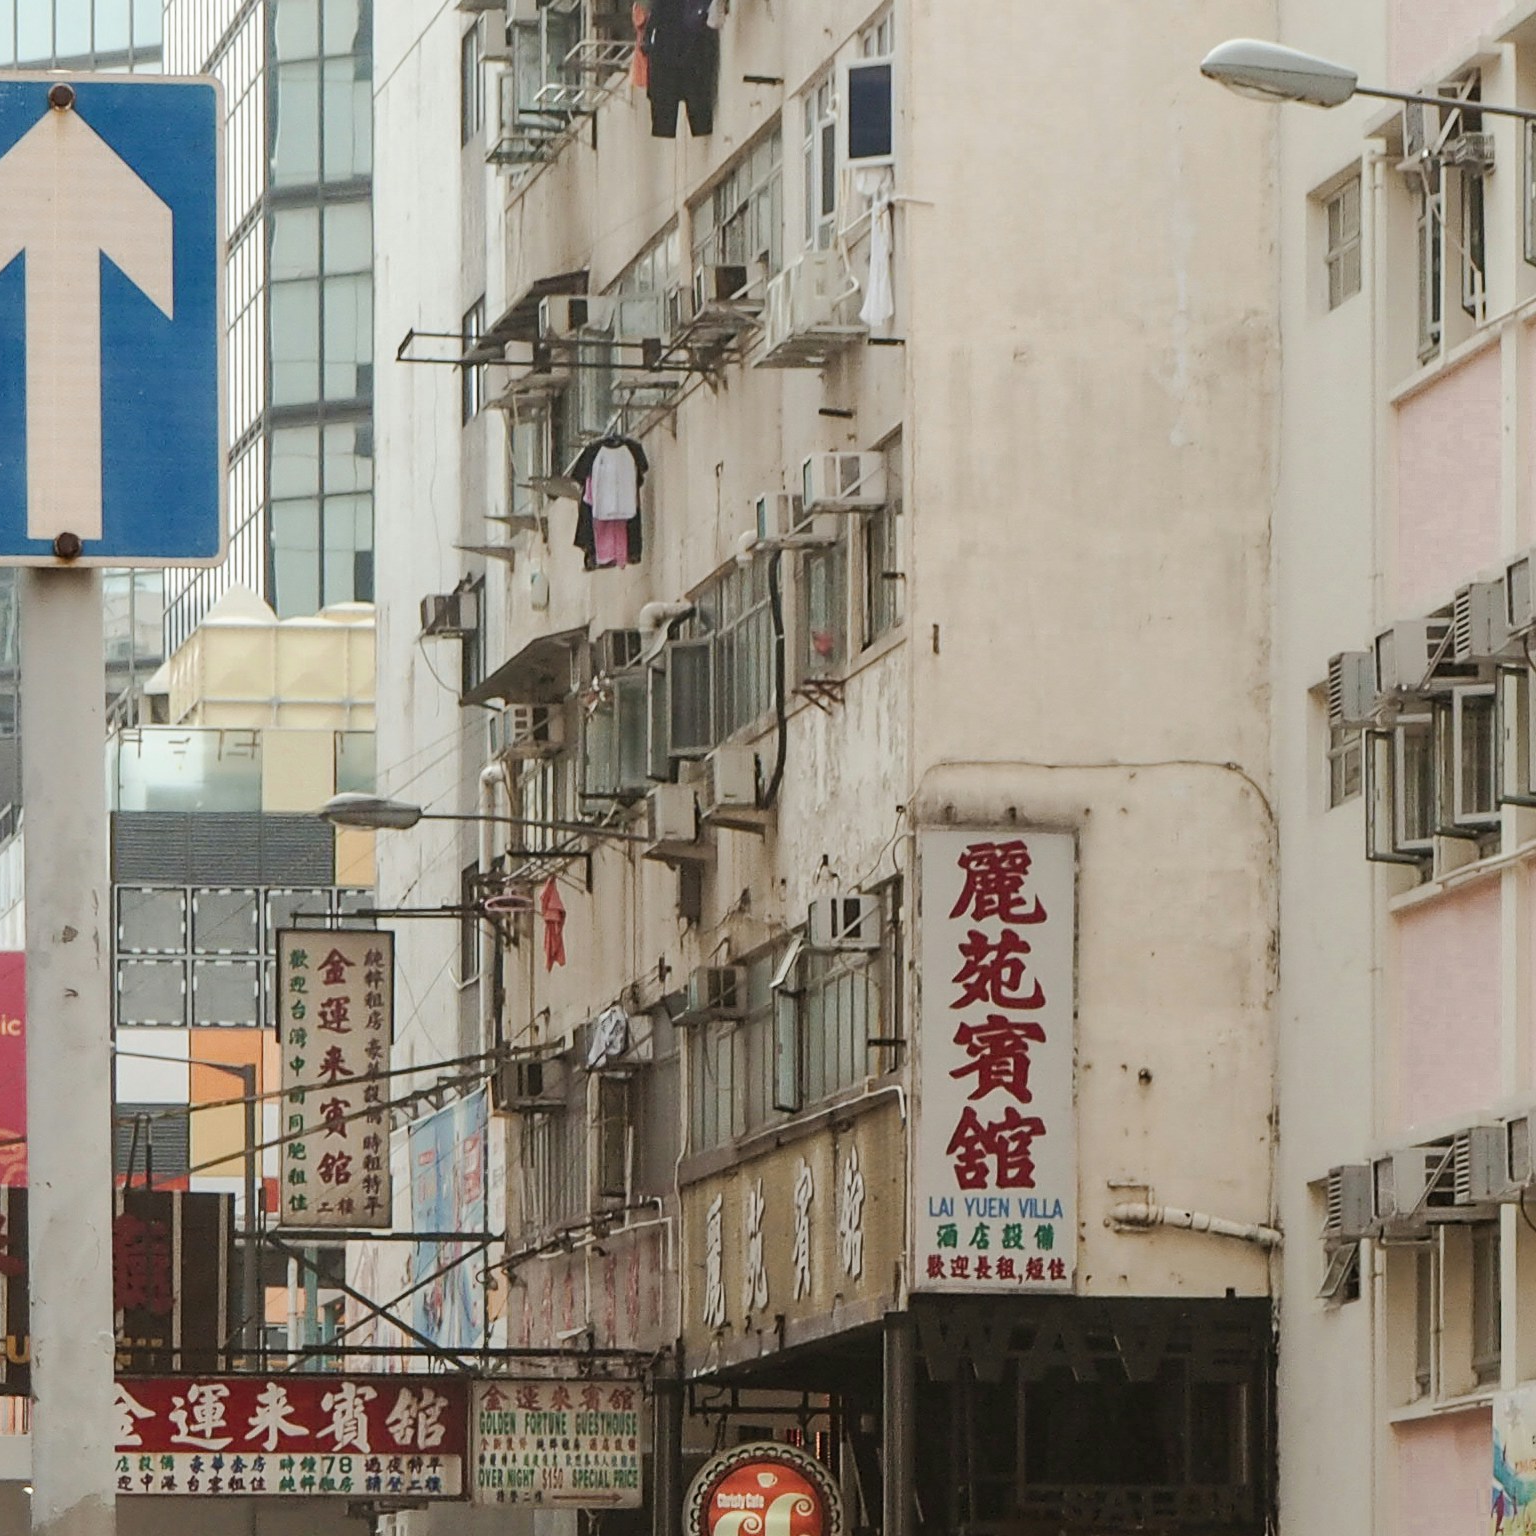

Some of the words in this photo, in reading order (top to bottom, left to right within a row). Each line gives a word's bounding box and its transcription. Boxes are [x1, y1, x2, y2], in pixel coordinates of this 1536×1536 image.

[929, 1197, 955, 1219] LAI
[965, 1196, 1010, 1219] YUEN
[1017, 1196, 1064, 1219] VILLA
[479, 1411, 516, 1436] GOLDEN
[524, 1412, 567, 1436] FORTUNE
[575, 1412, 638, 1437] GUESTHOUSE
[478, 1468, 504, 1489] OVER
[507, 1468, 535, 1489] NIGHT
[571, 1469, 611, 1489] SPECIAL
[613, 1469, 638, 1489] PRICE
